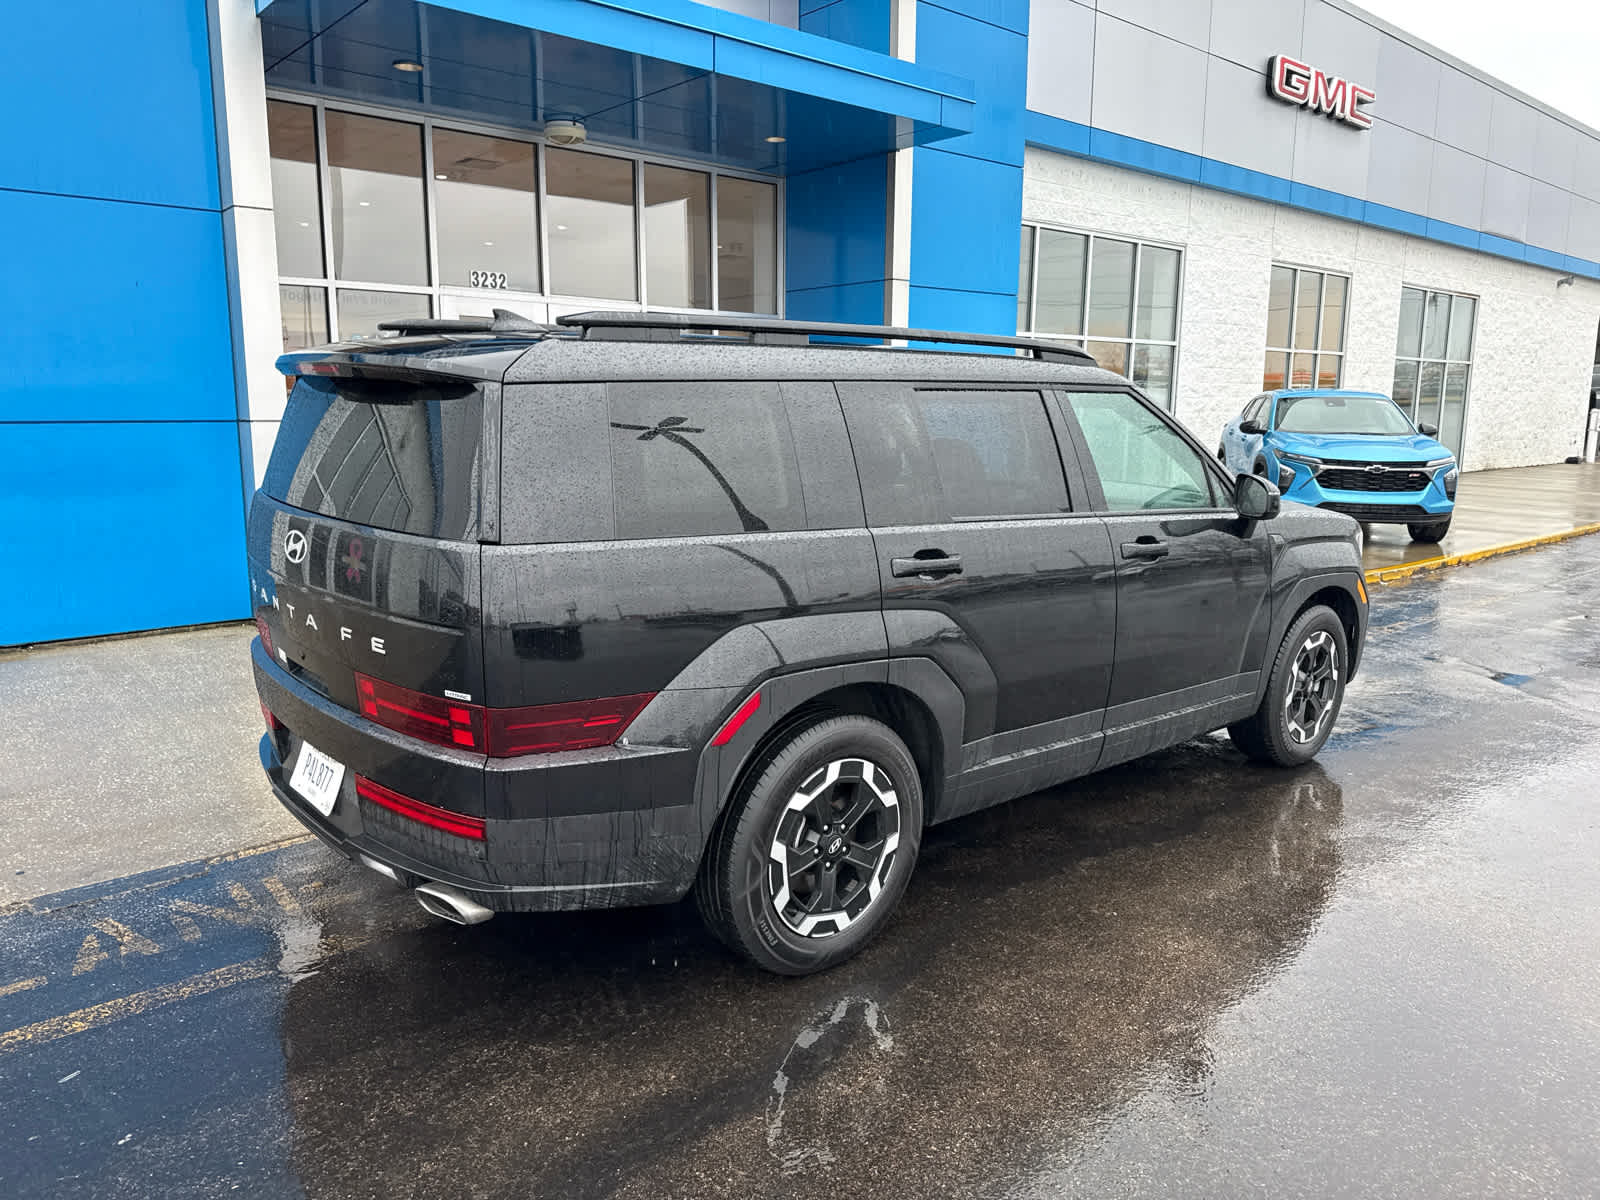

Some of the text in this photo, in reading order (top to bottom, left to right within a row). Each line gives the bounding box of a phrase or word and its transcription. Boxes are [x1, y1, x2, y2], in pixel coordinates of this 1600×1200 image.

[1271, 54, 1376, 129] GMC
[472, 271, 506, 289] 3232
[252, 579, 386, 655] SANTA FE
